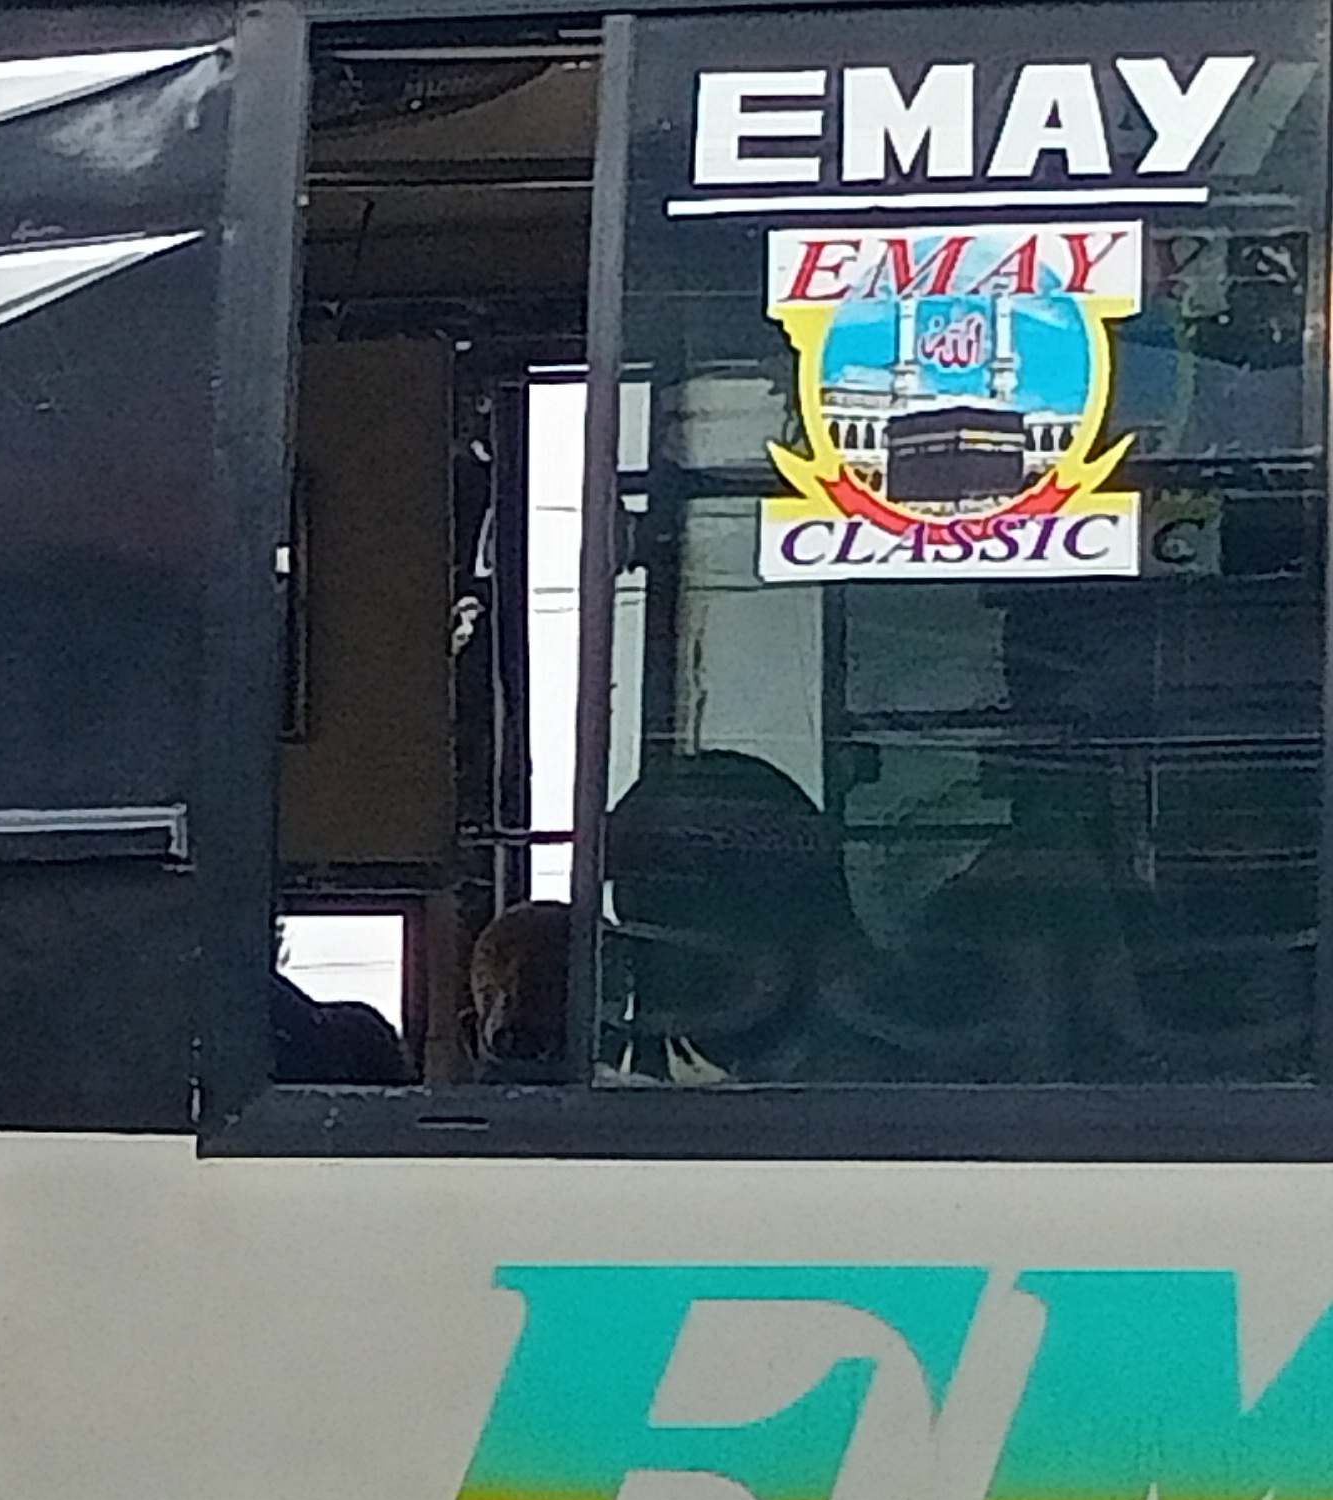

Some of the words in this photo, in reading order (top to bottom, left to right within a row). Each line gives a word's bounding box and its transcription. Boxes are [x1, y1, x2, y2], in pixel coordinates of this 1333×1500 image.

[692, 55, 1255, 184] EMAY
[779, 231, 1127, 303] EMAY
[780, 515, 1119, 567] CLASSIC
